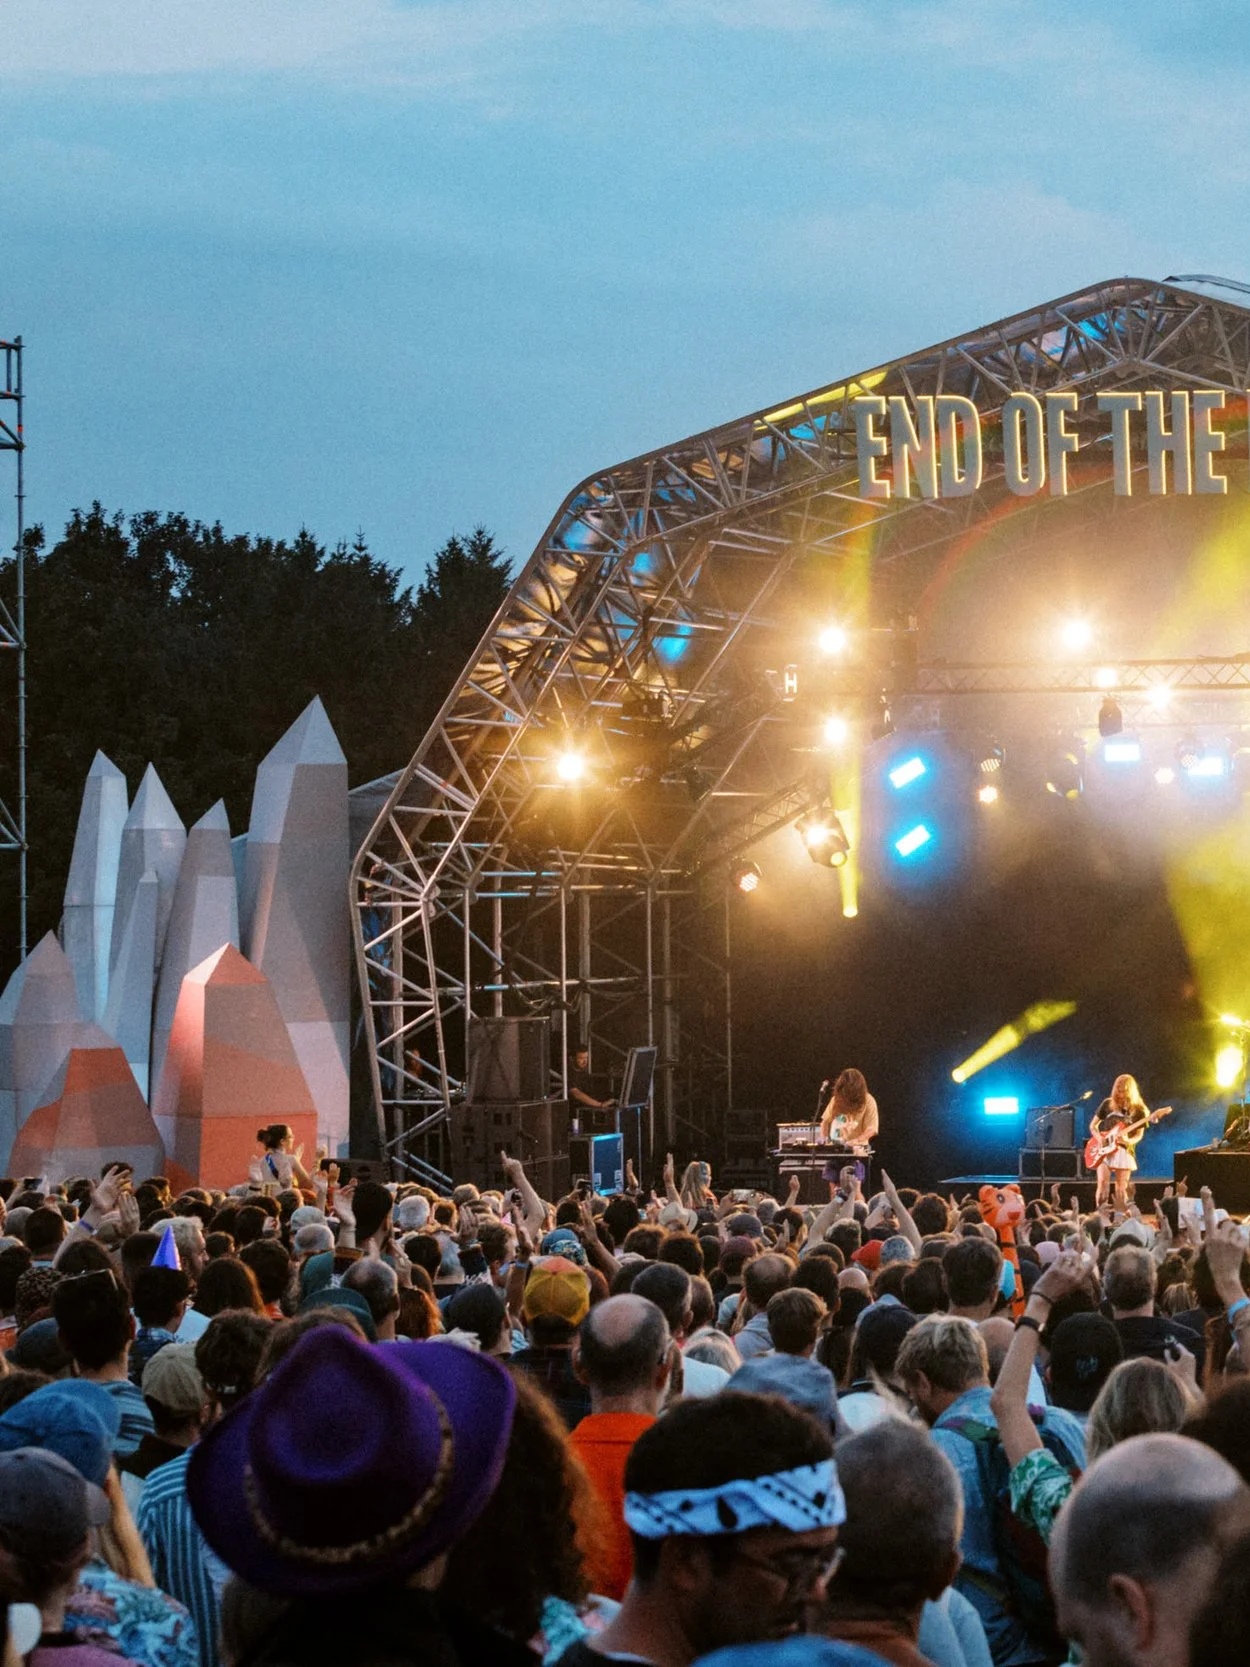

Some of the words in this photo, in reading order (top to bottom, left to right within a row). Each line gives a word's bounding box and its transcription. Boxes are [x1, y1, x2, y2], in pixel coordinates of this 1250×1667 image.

[855, 395, 983, 499] END
[1001, 391, 1079, 496] OF
[1097, 389, 1228, 496] THE
